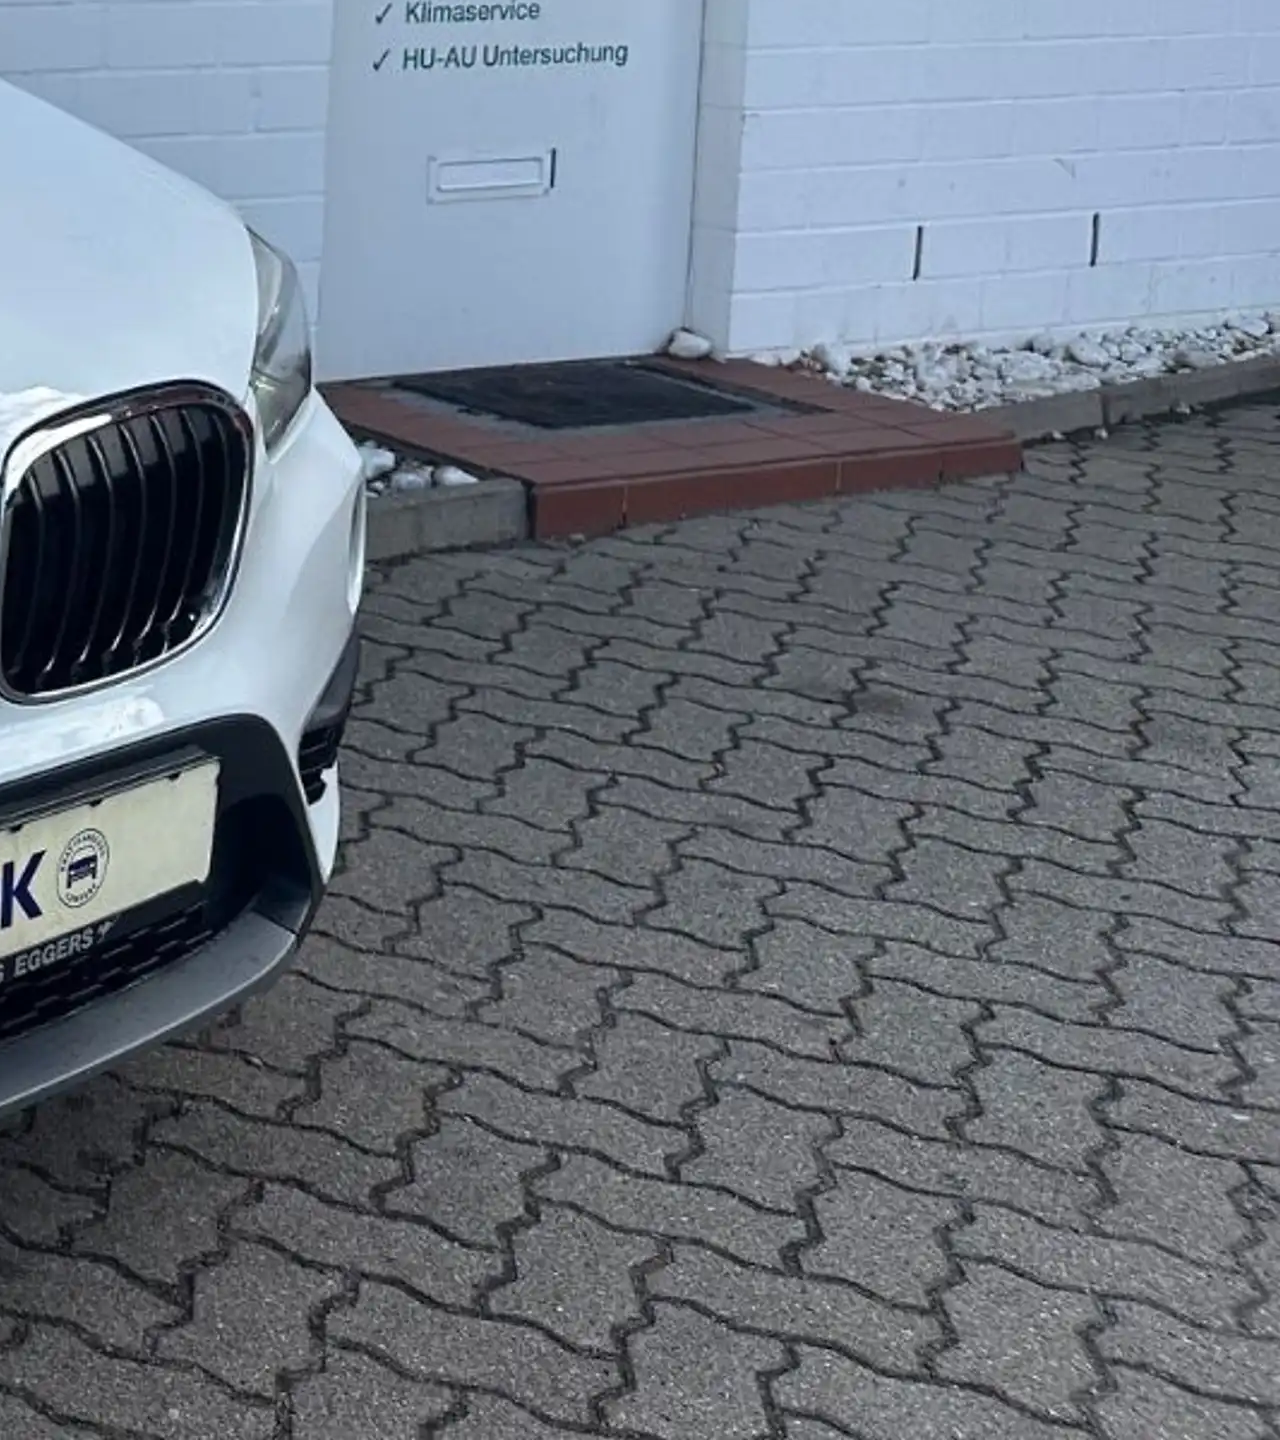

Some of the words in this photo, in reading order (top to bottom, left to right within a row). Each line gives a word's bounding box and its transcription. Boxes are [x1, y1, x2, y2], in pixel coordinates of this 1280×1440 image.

[404, 0, 541, 23] Klimaservice
[402, 47, 477, 70] HU-AU
[482, 42, 629, 68] Untersuchung
[13, 927, 94, 977] EGGERS
